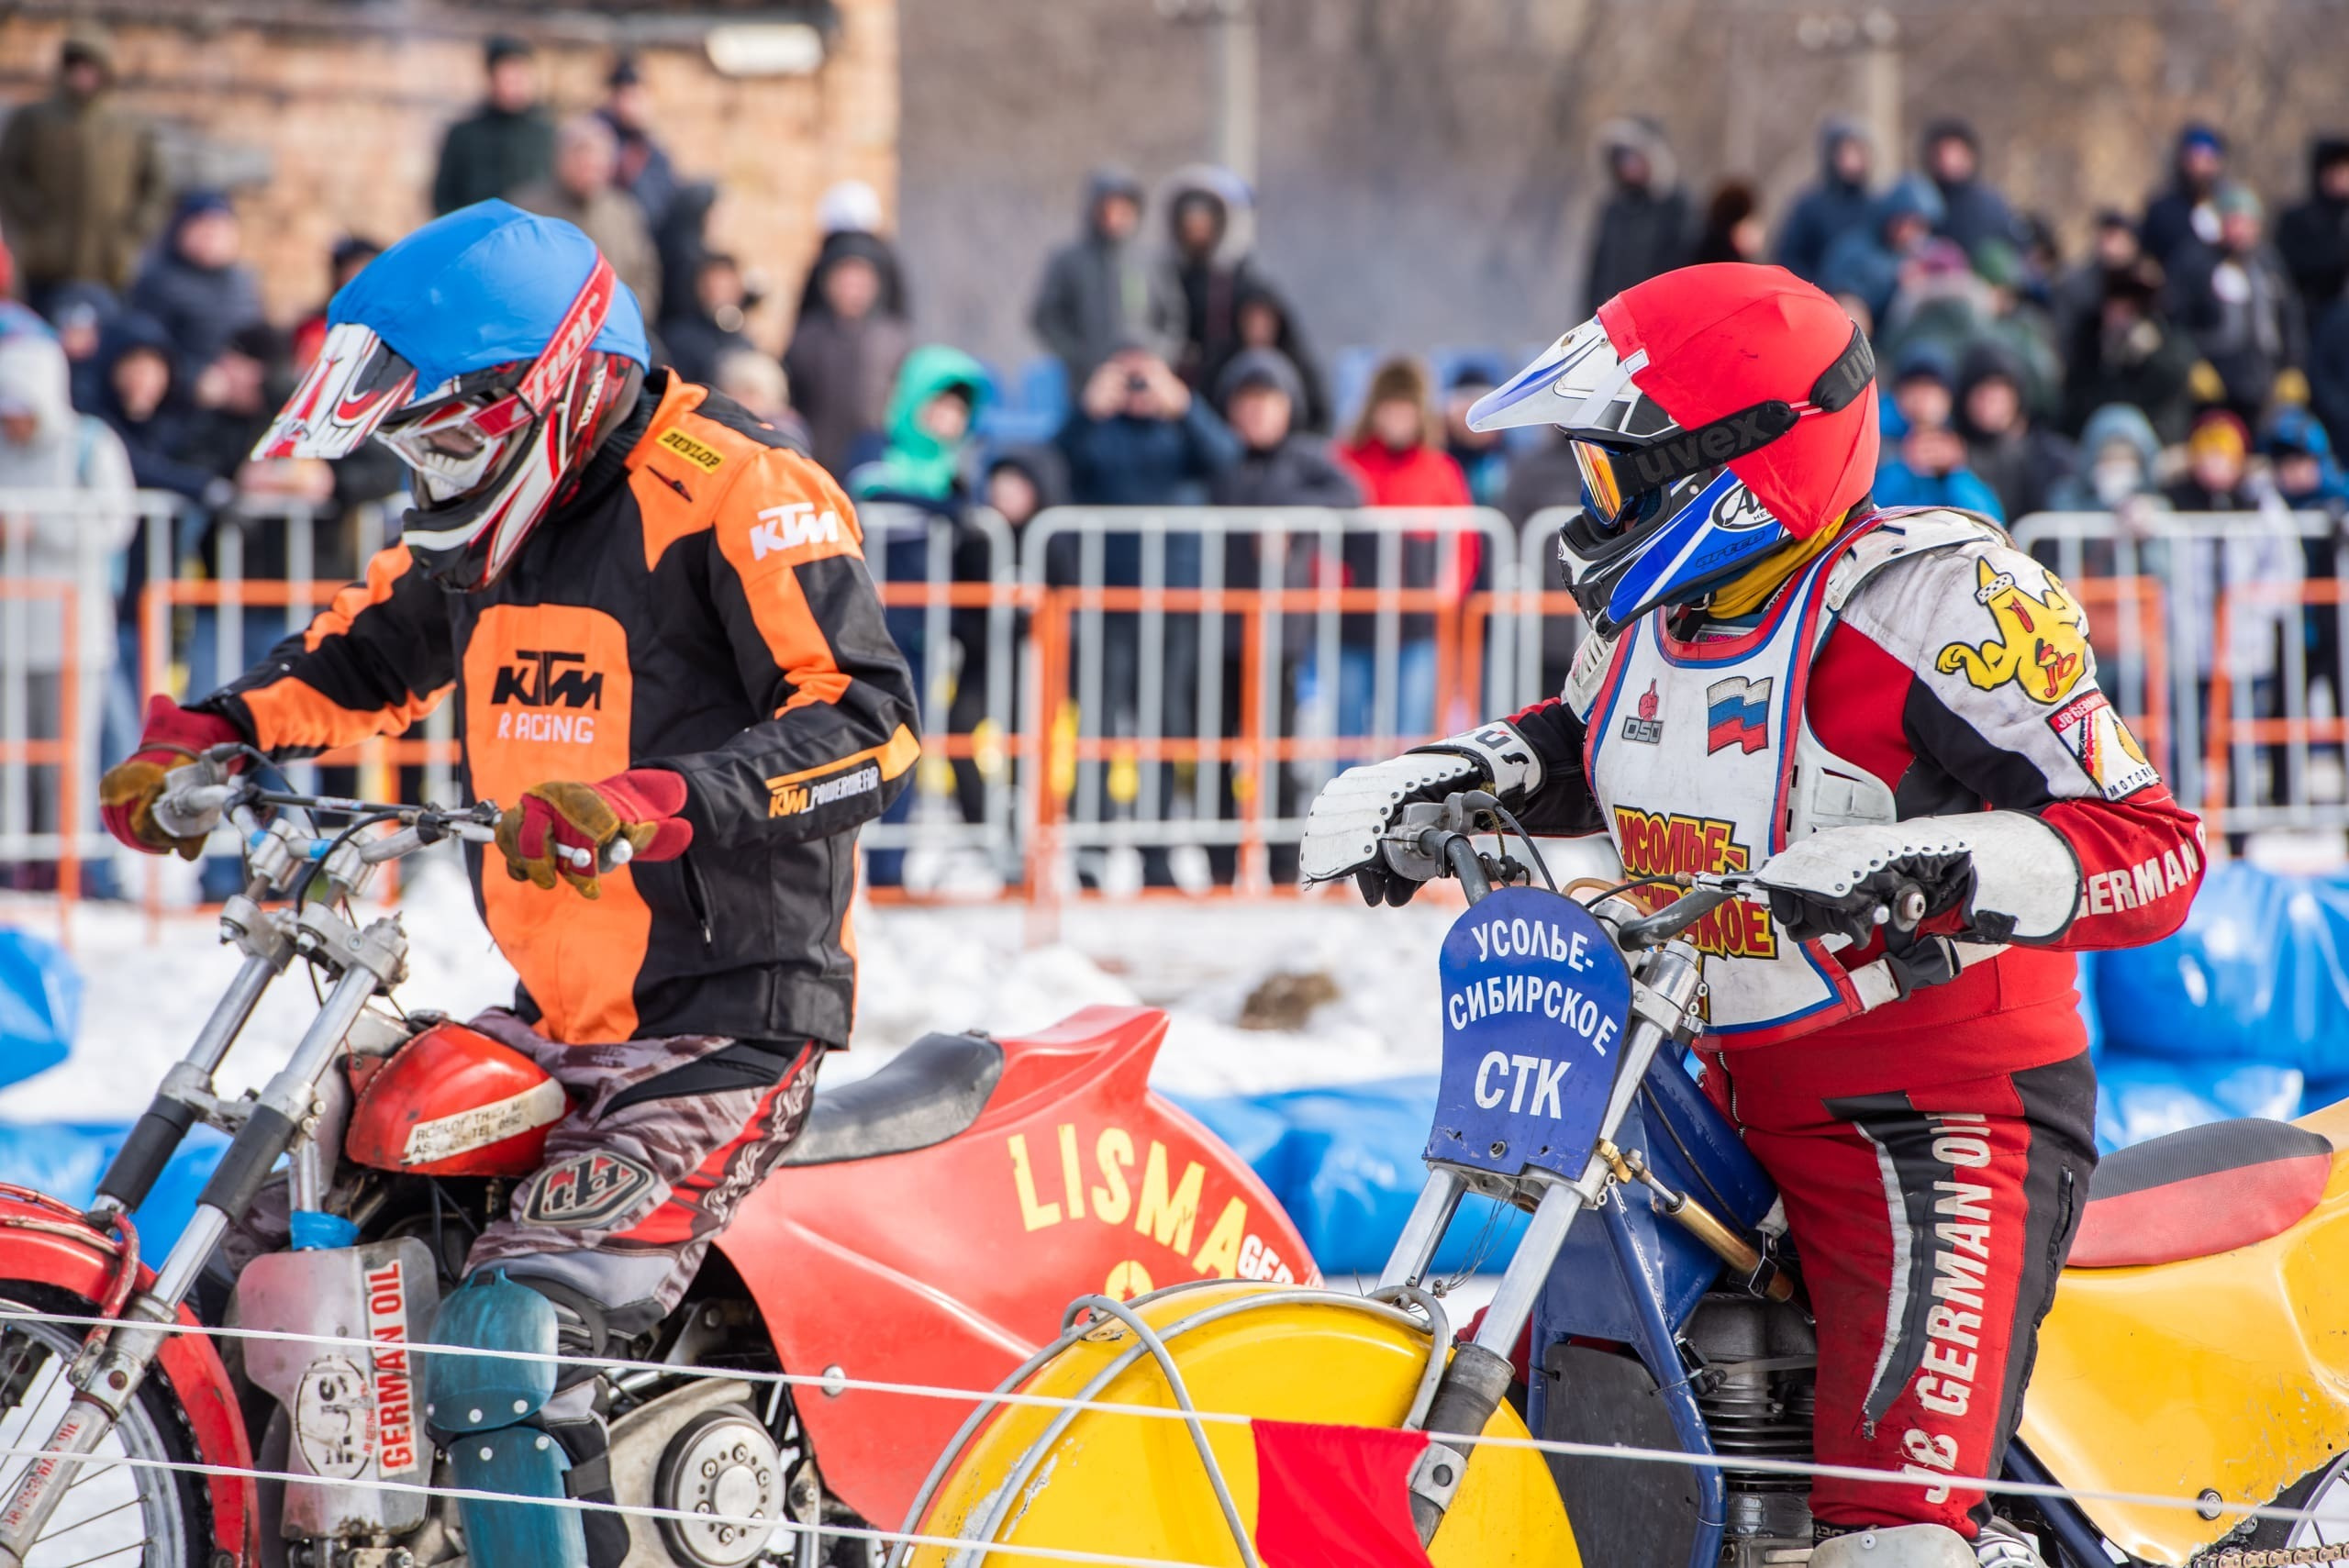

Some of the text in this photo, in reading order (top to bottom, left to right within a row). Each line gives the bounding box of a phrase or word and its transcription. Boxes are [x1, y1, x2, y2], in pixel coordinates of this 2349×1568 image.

[662, 432, 722, 468] DUNLOP
[1634, 411, 1772, 484] uvex
[749, 502, 840, 562] KTM
[491, 650, 605, 711] KTM
[769, 784, 808, 819] KTM
[1470, 917, 1595, 973] УСОЛЬЕ-
[1448, 974, 1619, 1057] СИБИРСКОЕ
[1474, 1051, 1572, 1120] СТК
[1007, 1122, 1248, 1280] LISMA
[1915, 1180, 1993, 1417] GERMAN
[369, 1262, 414, 1469] GERMAN OIL
